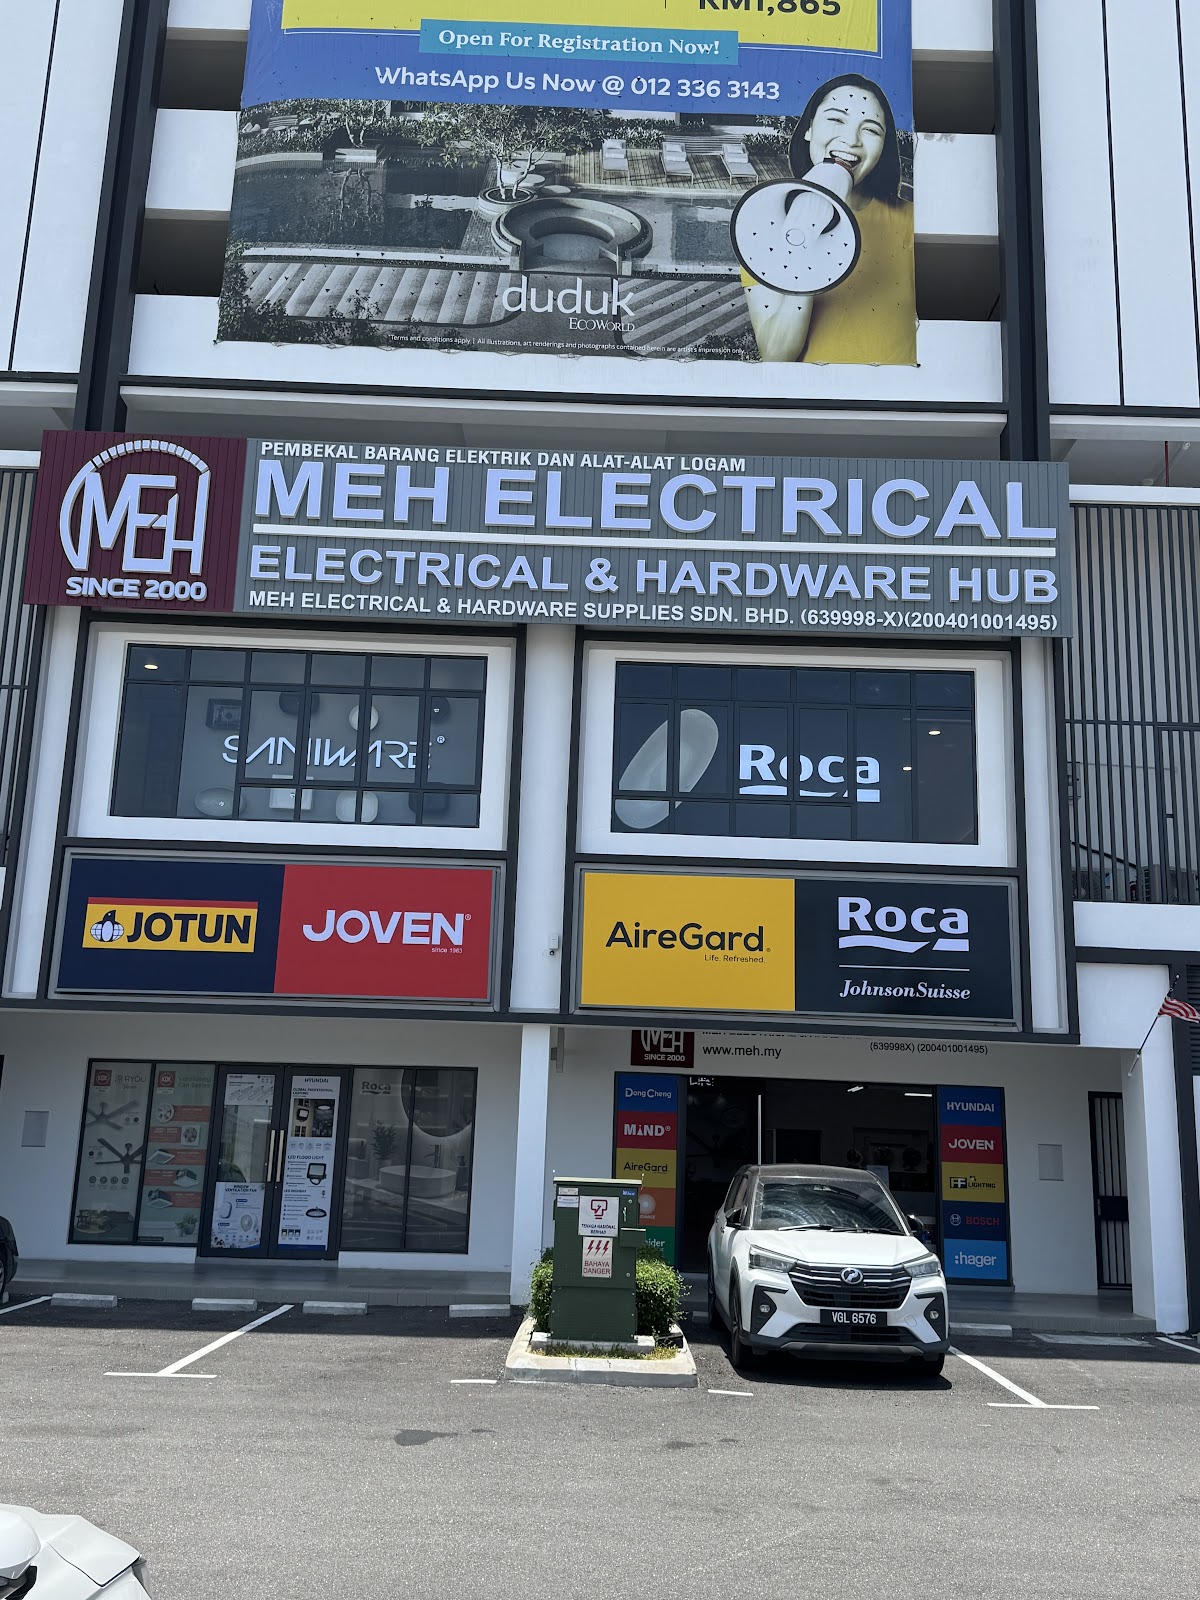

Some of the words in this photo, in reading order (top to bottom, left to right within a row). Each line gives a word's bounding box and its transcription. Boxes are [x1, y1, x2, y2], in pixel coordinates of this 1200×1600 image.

[438, 29, 496, 48] Open
[499, 31, 532, 48] For
[538, 33, 663, 53] Registration
[668, 38, 721, 55] Now!
[374, 66, 499, 94] WhatsApp
[505, 71, 536, 90] Us
[542, 73, 596, 93] Now
[601, 75, 625, 96] @
[630, 76, 671, 96] 012
[677, 78, 721, 99] 336
[727, 80, 781, 100] 3143
[502, 275, 636, 317] duduk
[422, 335, 454, 343] conditions
[454, 337, 472, 345] apply
[486, 338, 523, 347] illustrations,
[532, 341, 565, 349] renderings
[577, 342, 616, 351] photographs
[616, 343, 647, 351] contained
[698, 347, 731, 356] impression
[261, 441, 359, 460] PEMBEKAL
[364, 445, 440, 464] BARANG
[445, 449, 532, 466] ELEKTRIK
[536, 452, 575, 468] DAN
[580, 453, 675, 470] ALAT-ALAT
[680, 456, 746, 473] LOGAM
[254, 459, 450, 526] MEH
[484, 467, 1058, 541] ELECTRICAL
[60, 465, 211, 576] MEH
[250, 545, 569, 593] ELECTRICAL
[584, 556, 619, 594] &
[635, 558, 932, 602] HARDWARE
[948, 566, 1059, 605] HUB
[65, 576, 140, 598] SINCE
[143, 579, 208, 602] 2000
[249, 589, 295, 609] MEH
[301, 593, 431, 614] ELECTRICAL
[436, 597, 451, 614] &
[457, 598, 578, 619] HARDWARE
[583, 602, 685, 622] SUPPLIES
[690, 606, 739, 624] SDN.
[745, 606, 794, 625] BHD.
[738, 743, 881, 784] Roca
[837, 896, 970, 935] Roca
[126, 911, 252, 945] JOTUN
[302, 909, 465, 946] JOVEN
[604, 921, 765, 953] AireGard
[431, 946, 447, 954] since
[704, 954, 722, 963] Life.
[723, 955, 767, 965] Refreshed.
[643, 1053, 666, 1061] SINCE
[667, 1054, 686, 1062] 2000
[702, 1044, 782, 1060] www.meh.my
[869, 1041, 915, 1053] (639998X)
[917, 1043, 989, 1055] (200401001495)
[361, 1081, 392, 1091] Roca
[946, 1101, 995, 1113] HYUNDAI
[948, 1138, 995, 1151] JOVEN
[623, 1162, 669, 1173] AireGard
[967, 1181, 996, 1189] LIGHTING
[965, 1215, 1000, 1226] BOSCH
[583, 1267, 611, 1275] DANGER
[584, 1260, 610, 1268] BAHAYA
[831, 1311, 850, 1323] VGL
[851, 1312, 877, 1325] 6576
